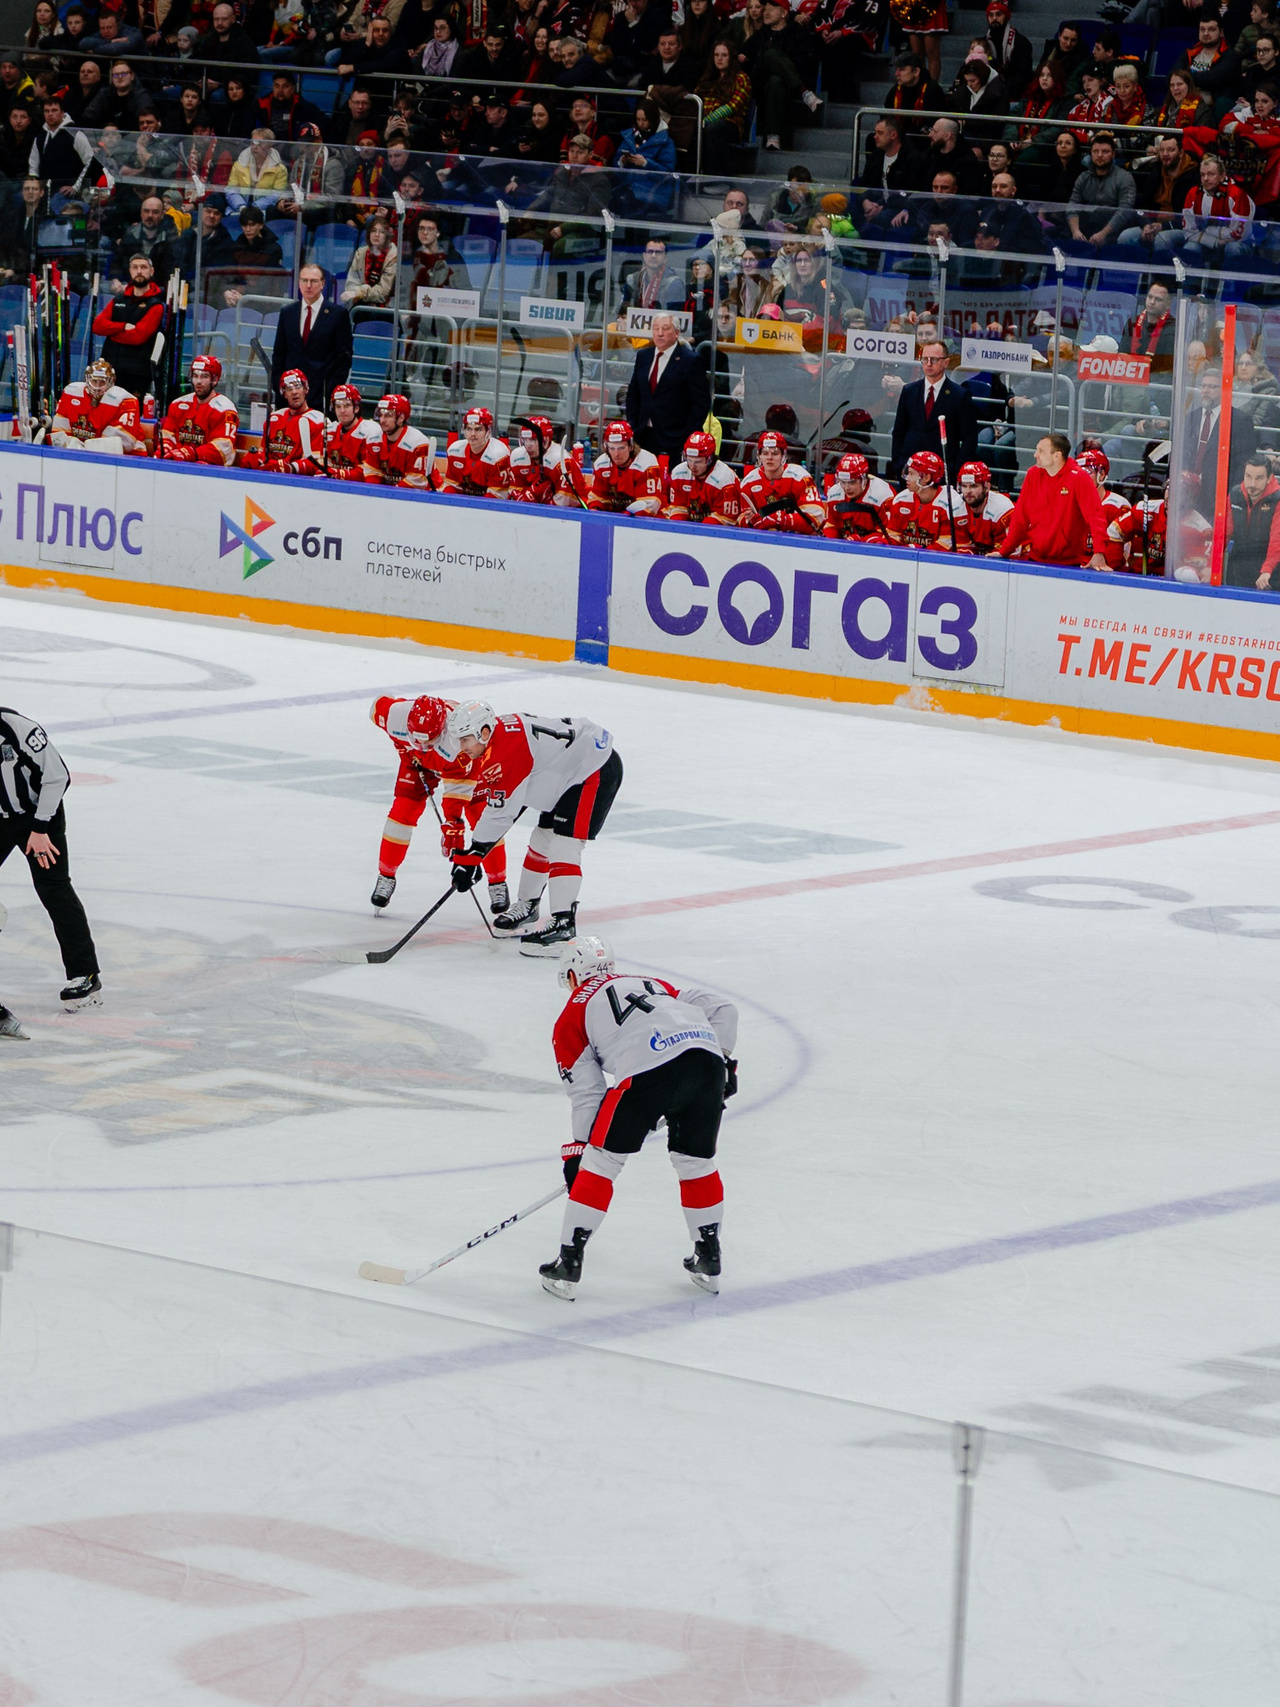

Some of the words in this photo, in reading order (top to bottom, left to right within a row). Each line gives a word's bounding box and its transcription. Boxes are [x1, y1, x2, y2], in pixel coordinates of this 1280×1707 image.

[528, 305, 575, 322] SIBUR
[762, 328, 795, 342] БАНК
[981, 348, 1029, 364] ГАЗПРОМБАНК
[1080, 355, 1149, 380] FONBET
[119, 412, 135, 428] 45
[224, 423, 237, 438] 12
[646, 479, 662, 494] 94
[723, 501, 739, 516] 86
[931, 509, 939, 524] C
[16, 482, 144, 555] Плюс
[283, 527, 343, 561] сбп
[366, 538, 432, 561] система
[436, 545, 507, 571] быстрых
[366, 559, 442, 584] платежей
[1059, 615, 1078, 626] МЫ
[1084, 618, 1127, 633] ВСЕГДА
[1133, 624, 1148, 636] НА
[1154, 626, 1193, 641] СВЯЗИ
[26, 728, 48, 752] 96
[597, 963, 609, 974] 44
[467, 1213, 518, 1249] CCM
